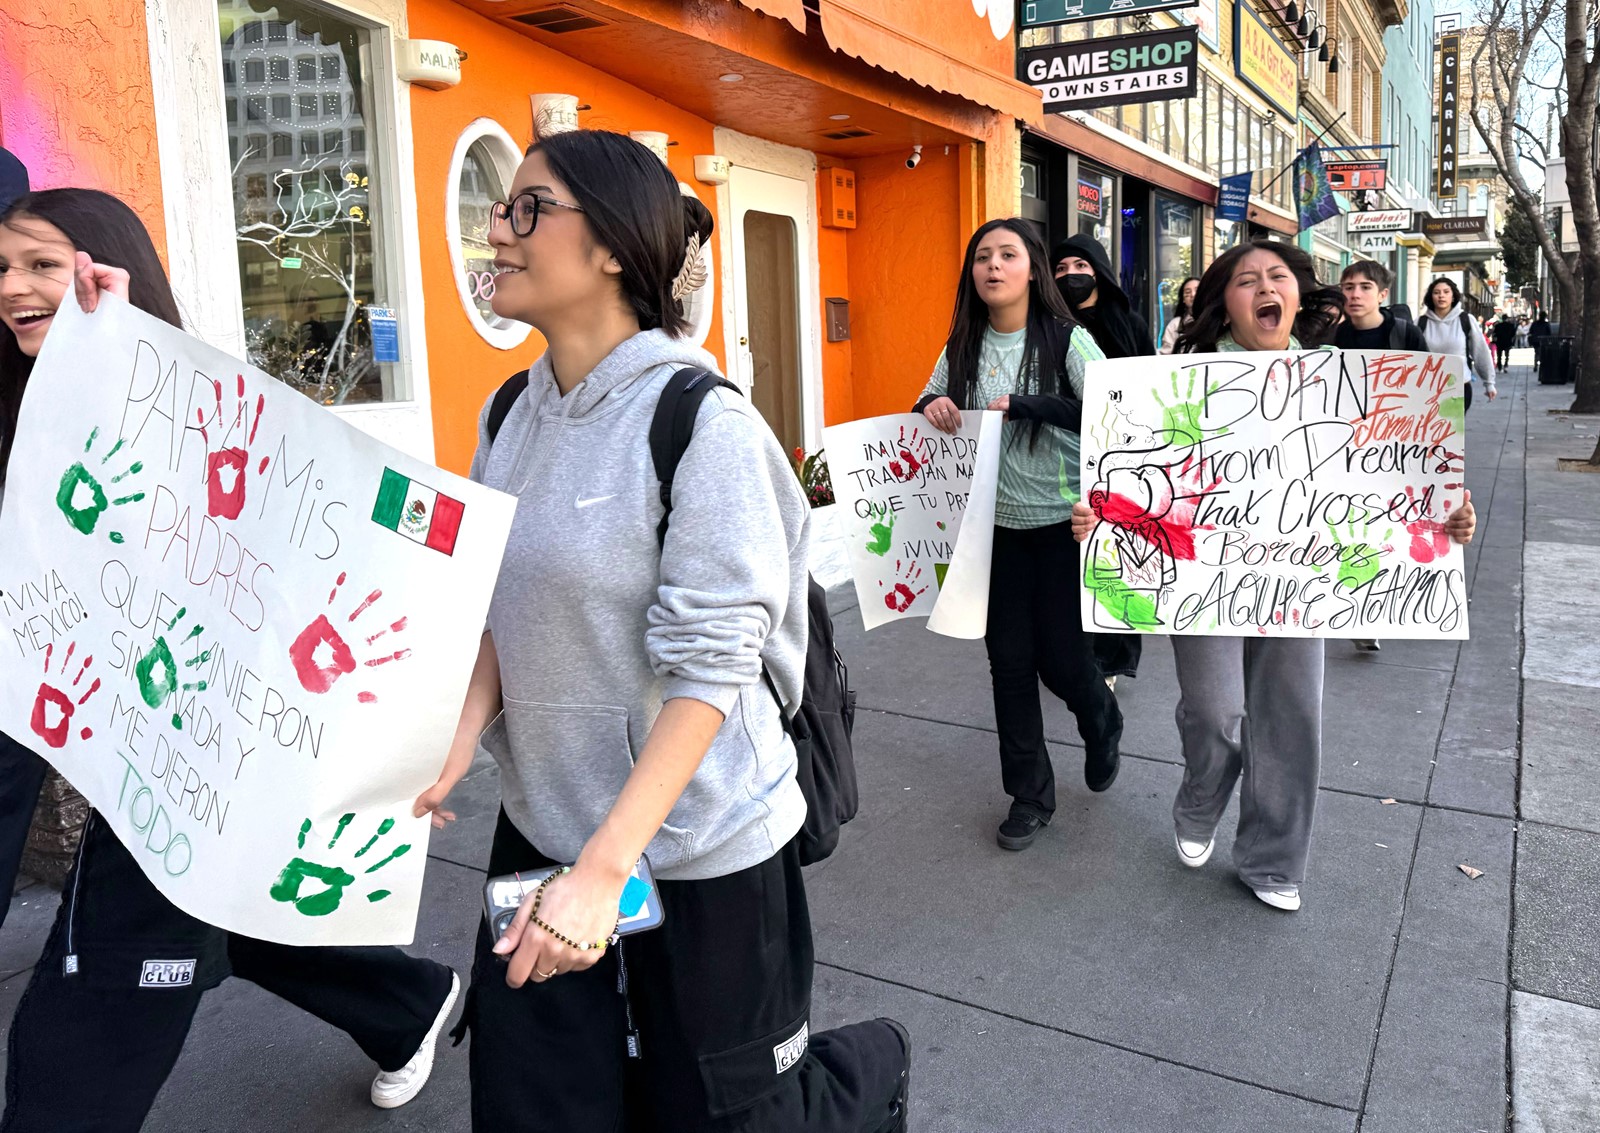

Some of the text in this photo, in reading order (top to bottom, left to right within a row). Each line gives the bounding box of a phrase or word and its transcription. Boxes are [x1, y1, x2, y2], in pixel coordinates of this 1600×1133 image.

[1027, 40, 1192, 82] GAMESHOP
[1039, 72, 1183, 99] OWNSTAIRS
[1442, 56, 1455, 189] CLARIANA
[1077, 199, 1100, 216] GAMES
[1078, 184, 1099, 202] VIDEO
[1364, 236, 1392, 247] ATM
[1443, 220, 1480, 230] CLARIANA
[1181, 350, 1368, 431] BORN
[118, 339, 249, 503] PARA
[1282, 421, 1456, 481] Dreams
[855, 496, 905, 518] QUE
[912, 493, 937, 510] TU
[1277, 479, 1441, 534] Crossed
[144, 484, 275, 632] PADRES
[1201, 531, 1391, 568] Borders
[13, 592, 88, 658] MEXICO!
[101, 559, 324, 759] QUE VINIERON
[109, 693, 231, 836] ME DIERON
[236, 737, 256, 780] Y
[114, 750, 193, 878] TODO
[144, 972, 191, 983] CLUB
